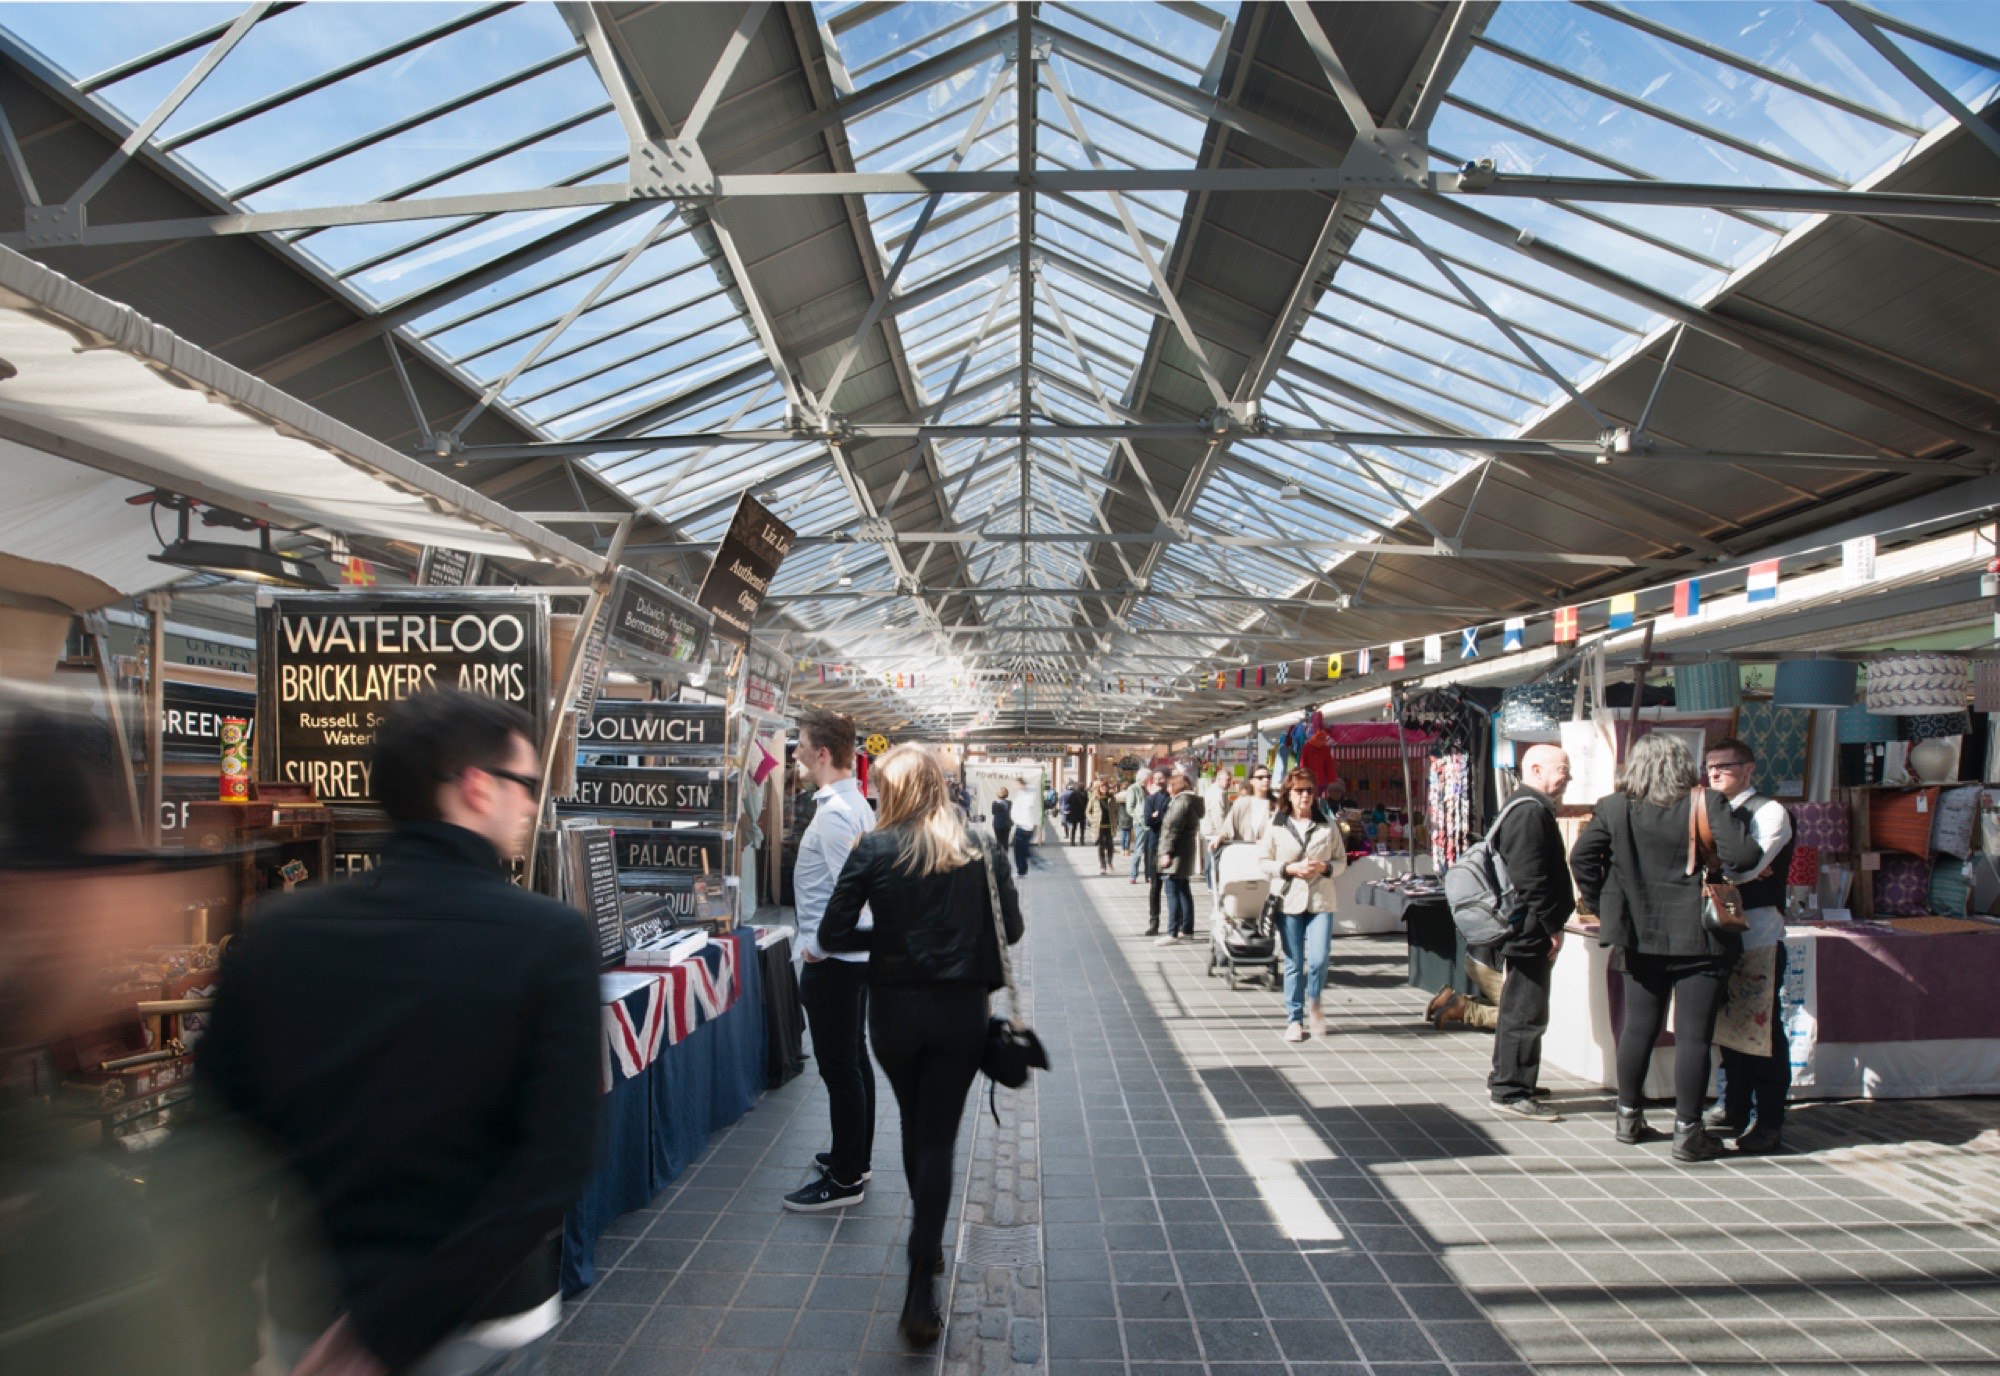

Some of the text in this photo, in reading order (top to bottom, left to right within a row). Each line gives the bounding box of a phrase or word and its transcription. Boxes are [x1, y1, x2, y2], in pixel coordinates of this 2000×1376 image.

[282, 614, 525, 654] WATERLOO
[282, 662, 525, 702] BRICKLAYERS ARMS
[300, 712, 359, 728] Russell
[611, 782, 668, 807] DOCKS
[676, 785, 710, 808] STN
[629, 844, 699, 868] PALACE
